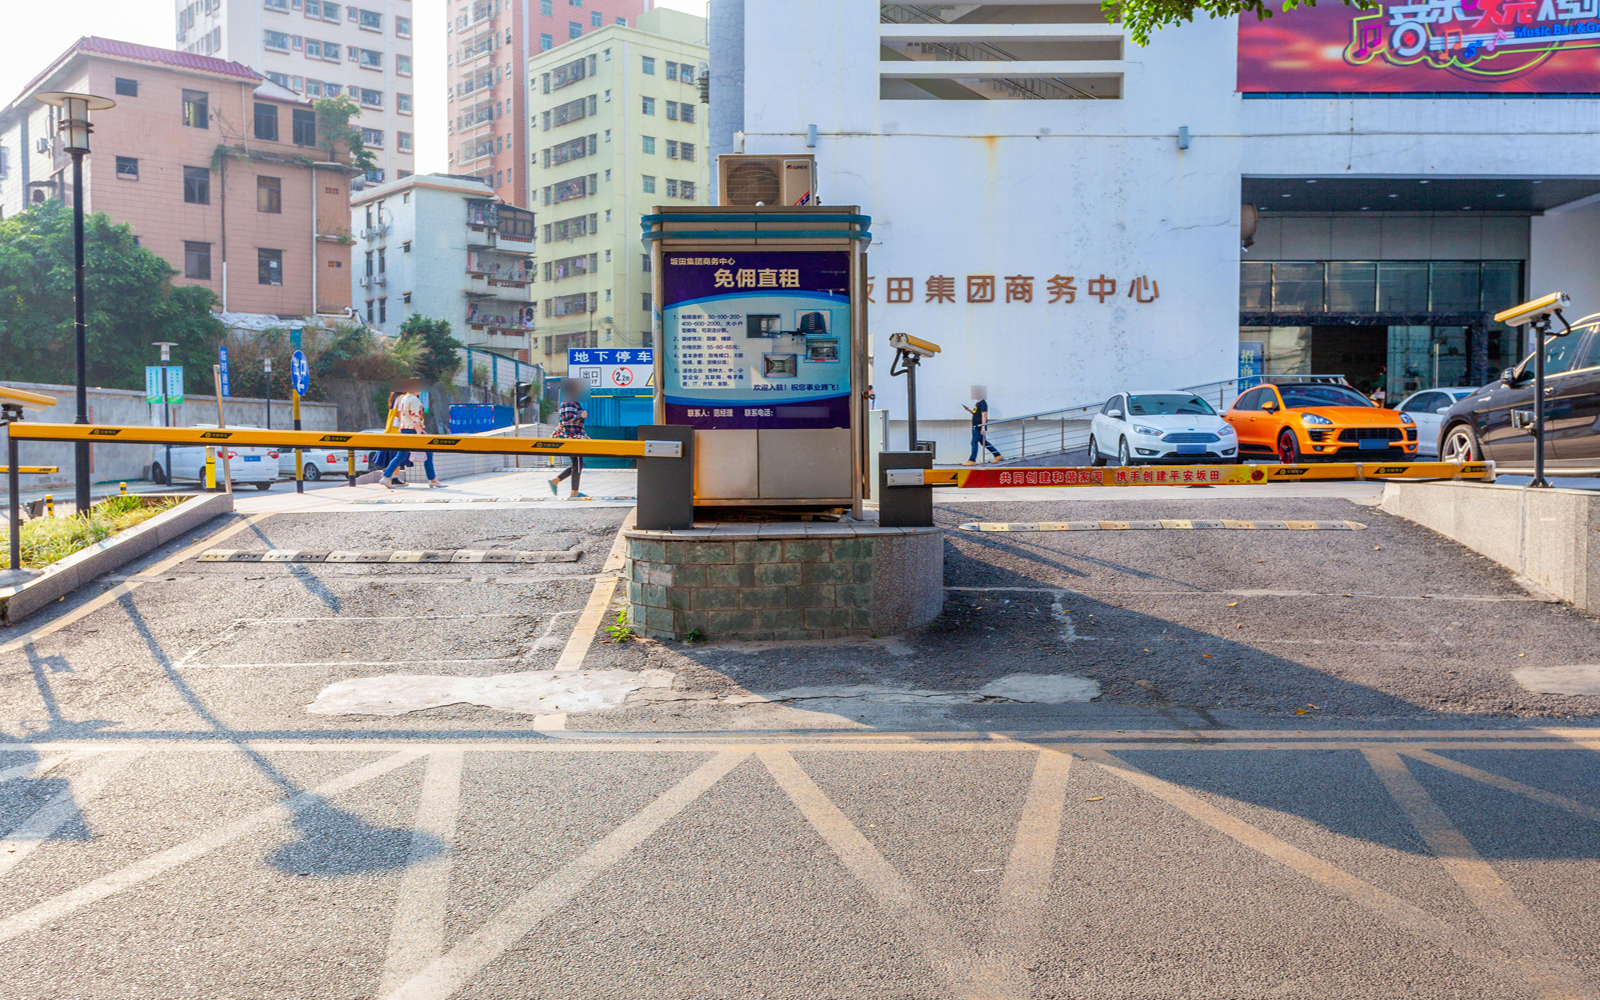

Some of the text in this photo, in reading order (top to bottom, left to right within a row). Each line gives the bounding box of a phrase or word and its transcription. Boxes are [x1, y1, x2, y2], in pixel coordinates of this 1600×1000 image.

[1514, 25, 1551, 38] Music
[1553, 23, 1574, 35] Bar
[669, 257, 736, 266] 坂田集团商务中心
[713, 268, 801, 288] 免佣直租
[573, 351, 653, 363] 地下停车
[583, 370, 598, 379] 出口
[1000, 470, 1220, 485] 共同创建和谐家园 携手创建平安坂田
